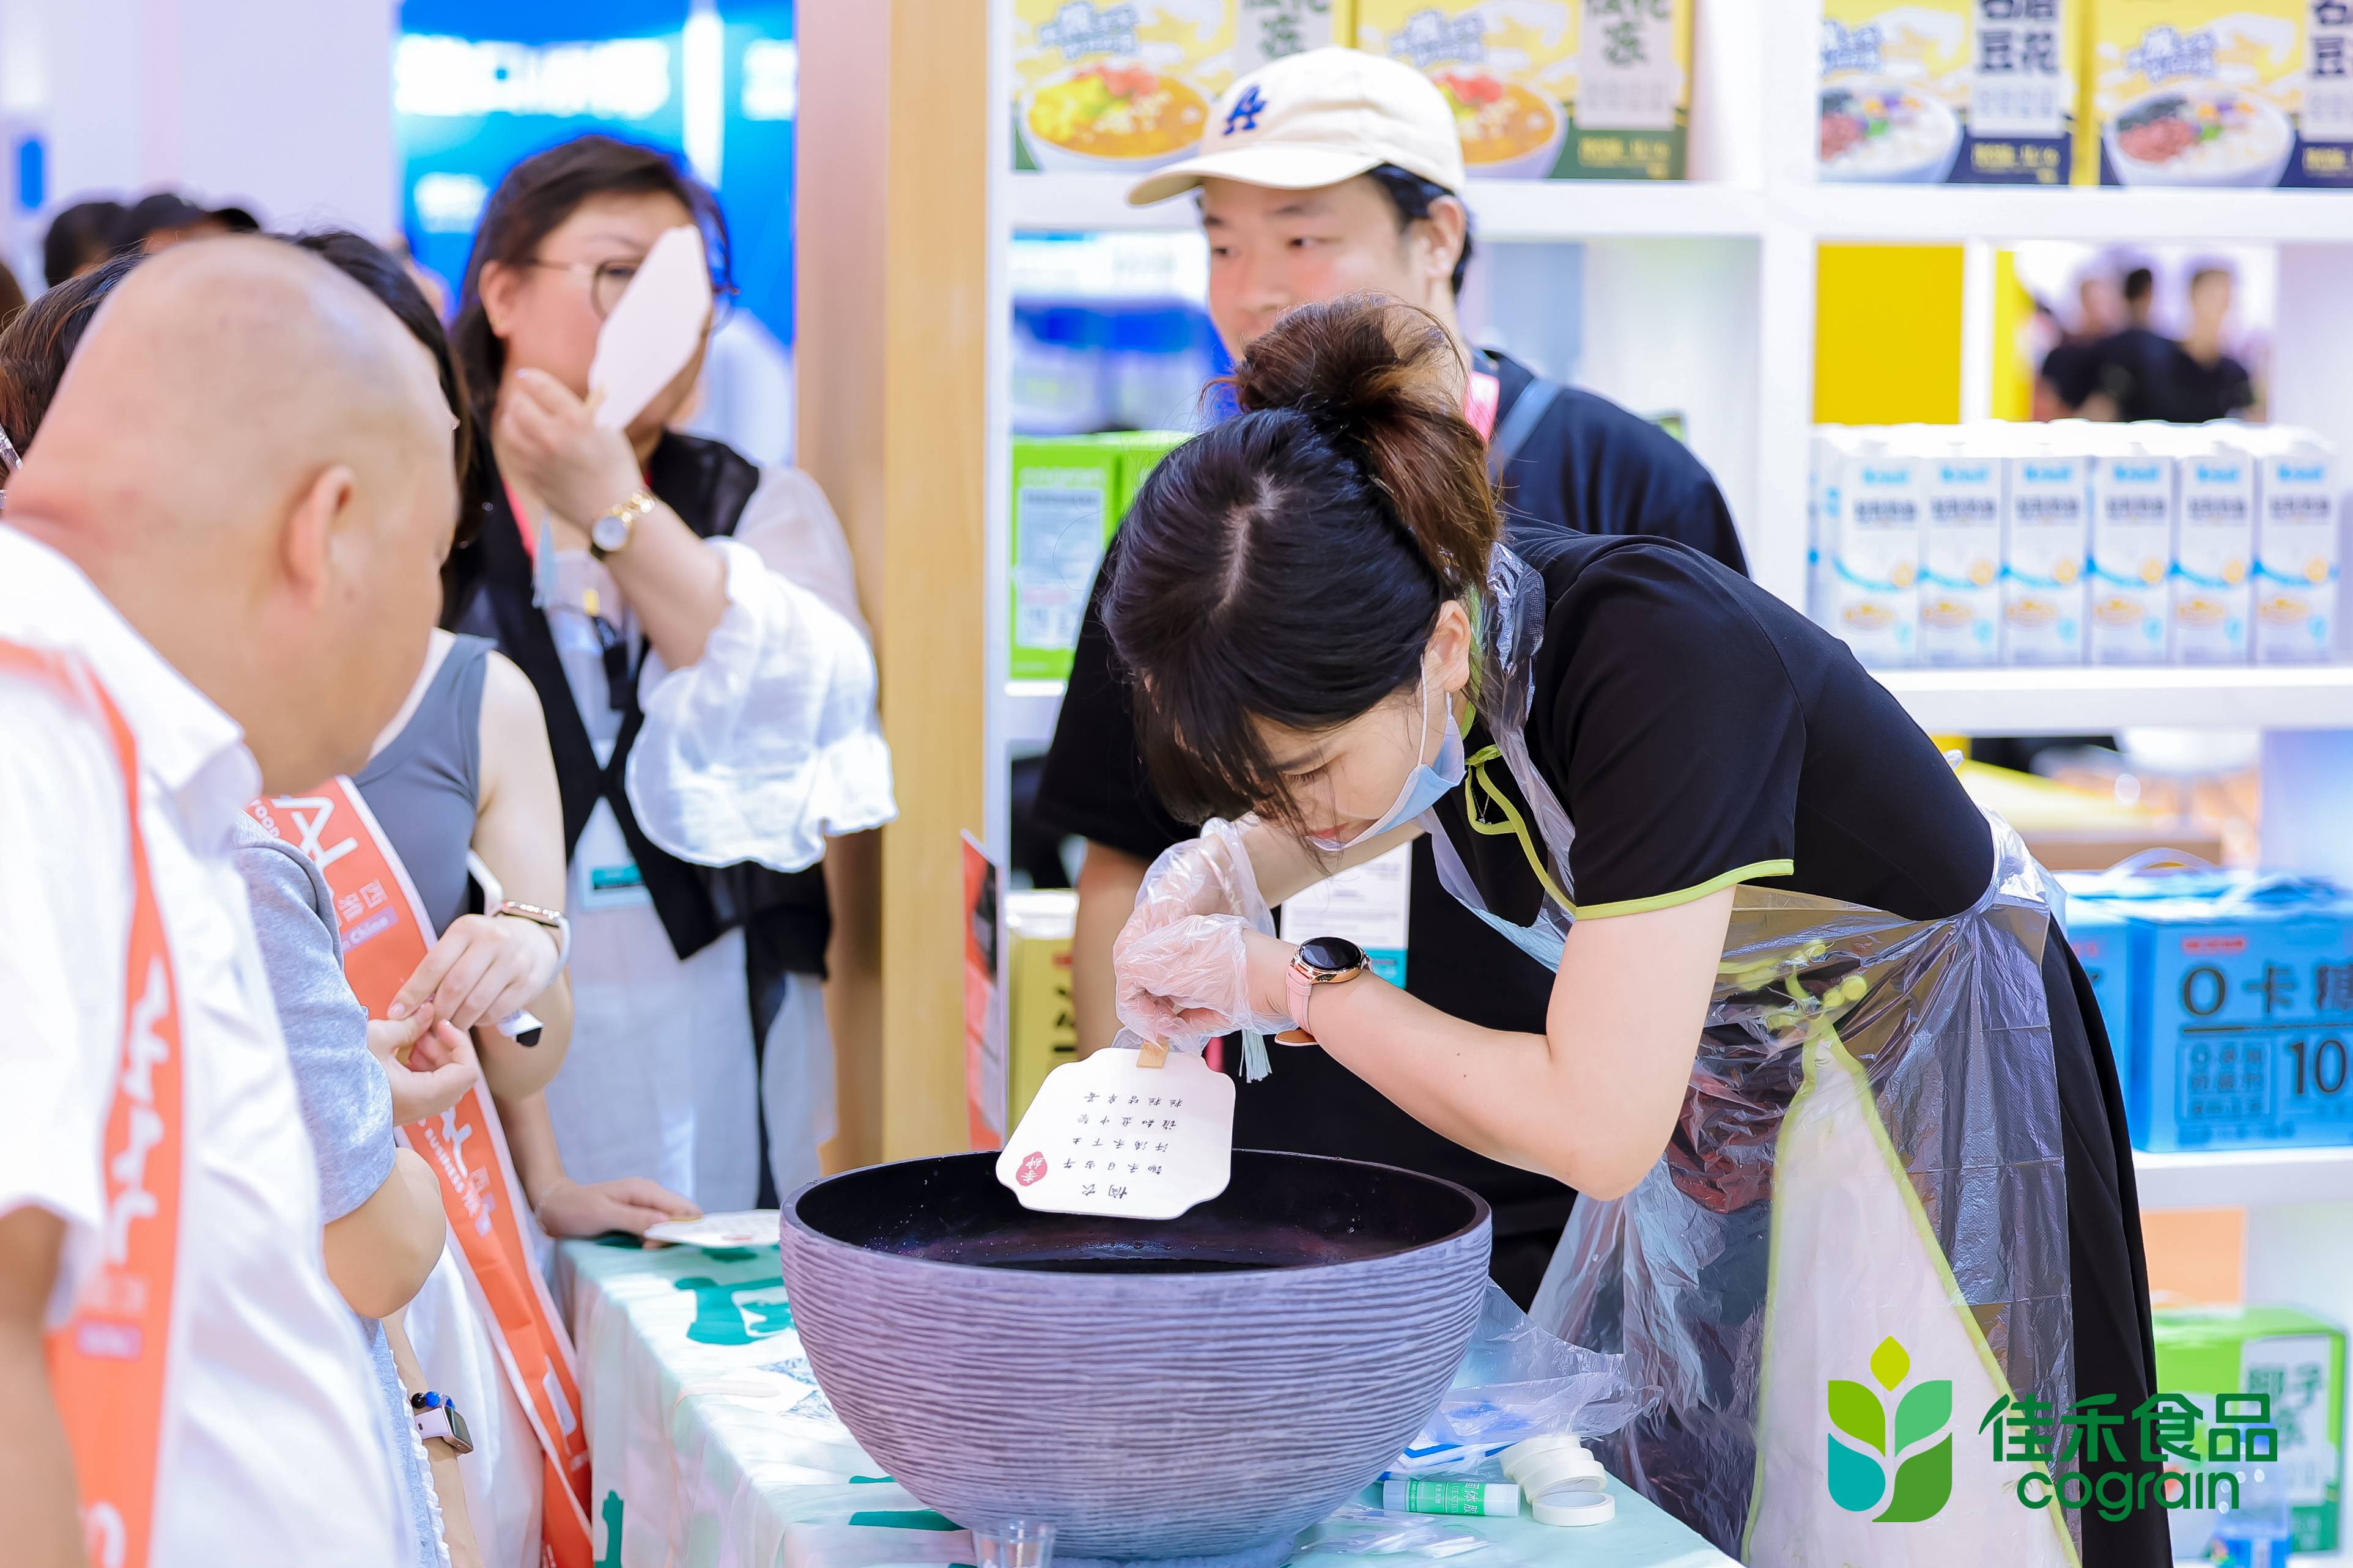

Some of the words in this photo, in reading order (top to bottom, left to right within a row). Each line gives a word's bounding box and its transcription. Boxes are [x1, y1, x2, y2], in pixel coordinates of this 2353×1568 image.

[1084, 1092, 1183, 1108] 粒粒皆辛苦
[1073, 1138, 1169, 1152] 汗滴禾下土
[1063, 1158, 1162, 1175] 锄禾日当午
